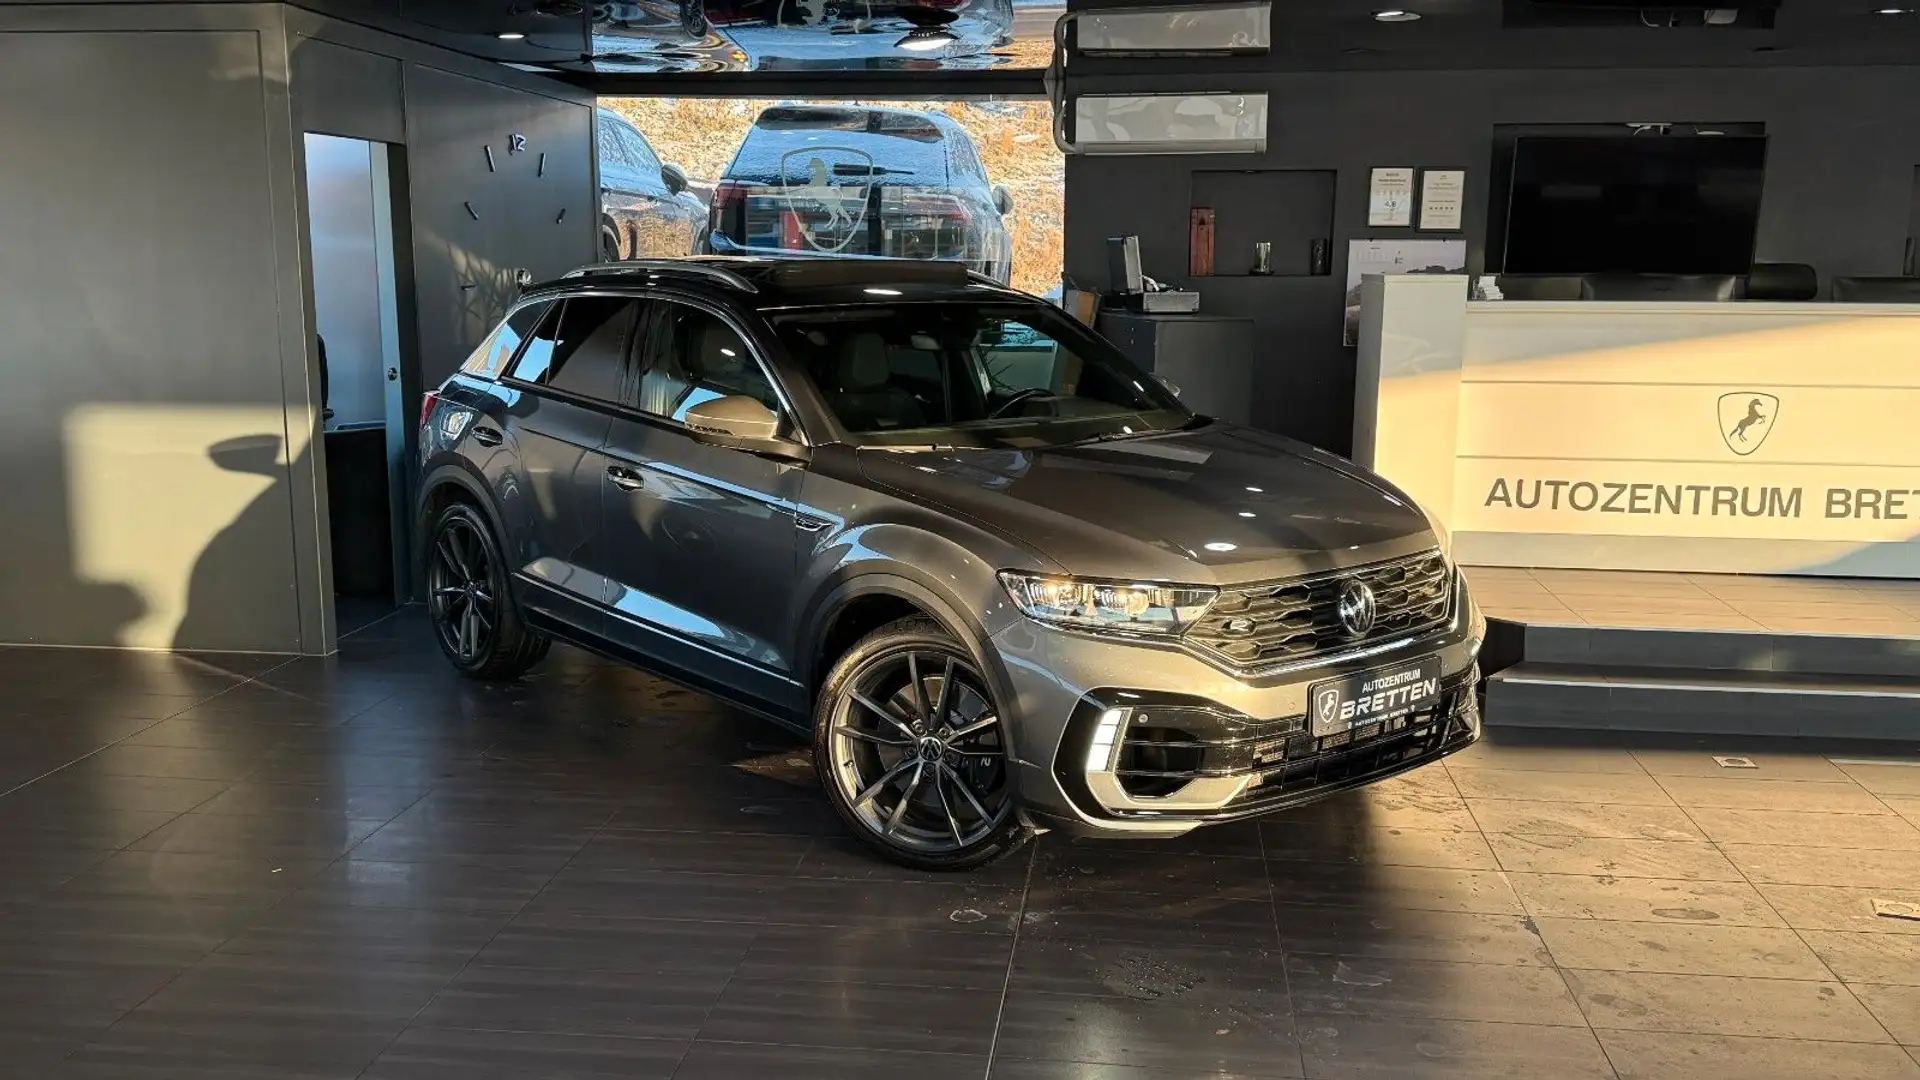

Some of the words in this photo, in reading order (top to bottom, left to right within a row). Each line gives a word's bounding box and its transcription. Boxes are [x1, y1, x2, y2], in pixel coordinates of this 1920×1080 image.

[509, 134, 526, 152] 12
[1484, 478, 1803, 518] AUTOZENTRUM
[1362, 668, 1421, 693] AUTOZENTRUM
[1340, 677, 1437, 720] BRETTEN
